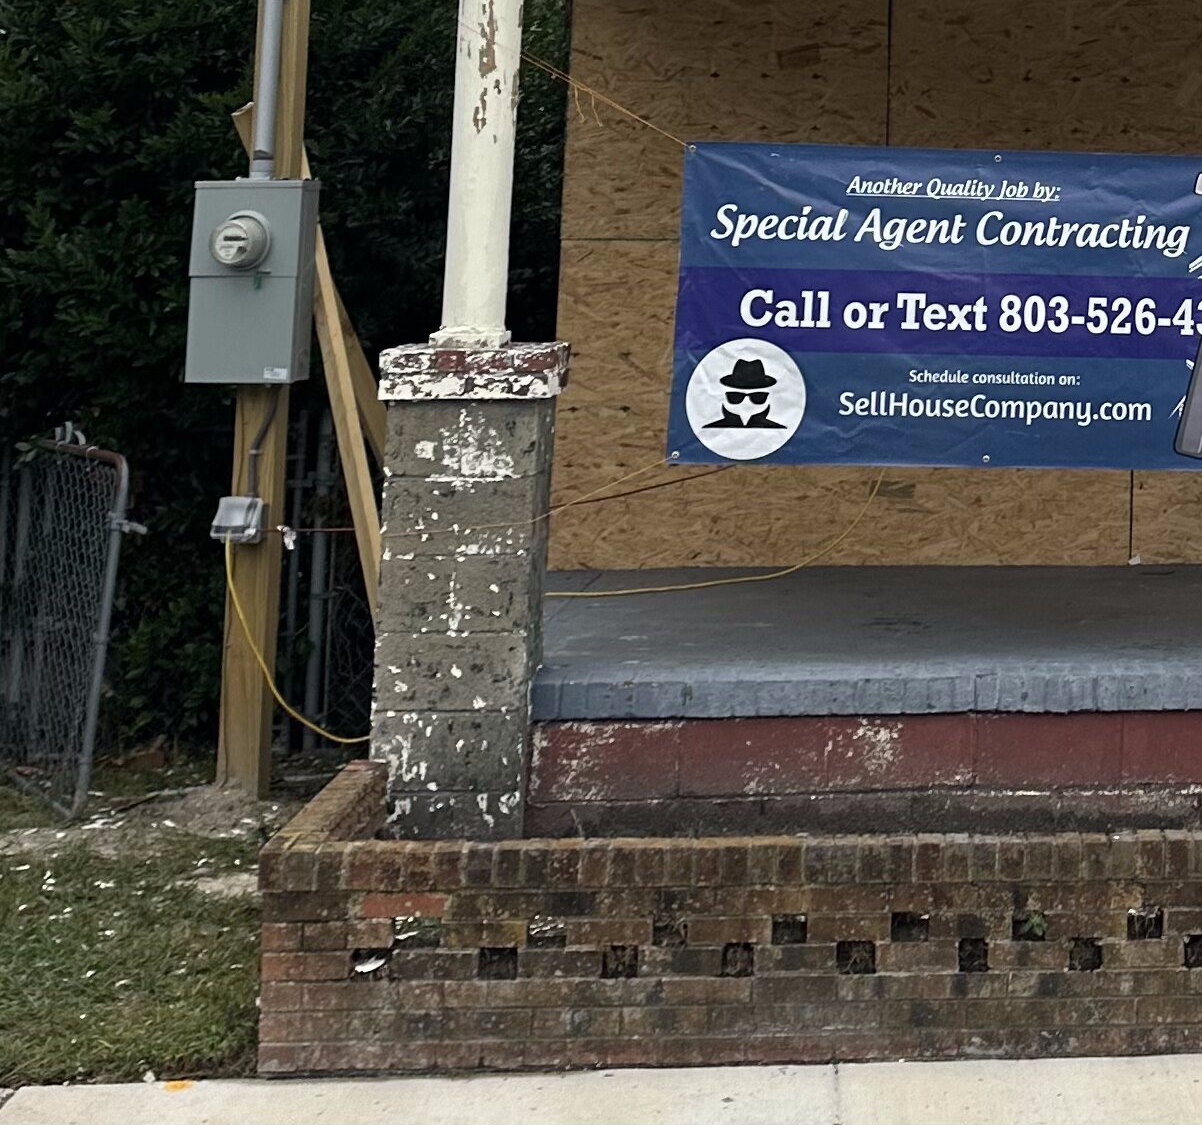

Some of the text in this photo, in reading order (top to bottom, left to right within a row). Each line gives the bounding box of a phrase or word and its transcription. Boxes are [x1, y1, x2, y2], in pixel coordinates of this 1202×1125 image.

[846, 176, 1062, 203] Another Quality Job by:
[710, 203, 1191, 258] Special Agent Contracting
[740, 289, 831, 328] Call
[843, 301, 889, 329] or
[896, 292, 988, 332] Text
[909, 369, 1081, 387] Schedule consultation on:
[838, 390, 1152, 427] SellHouseCompany.com
